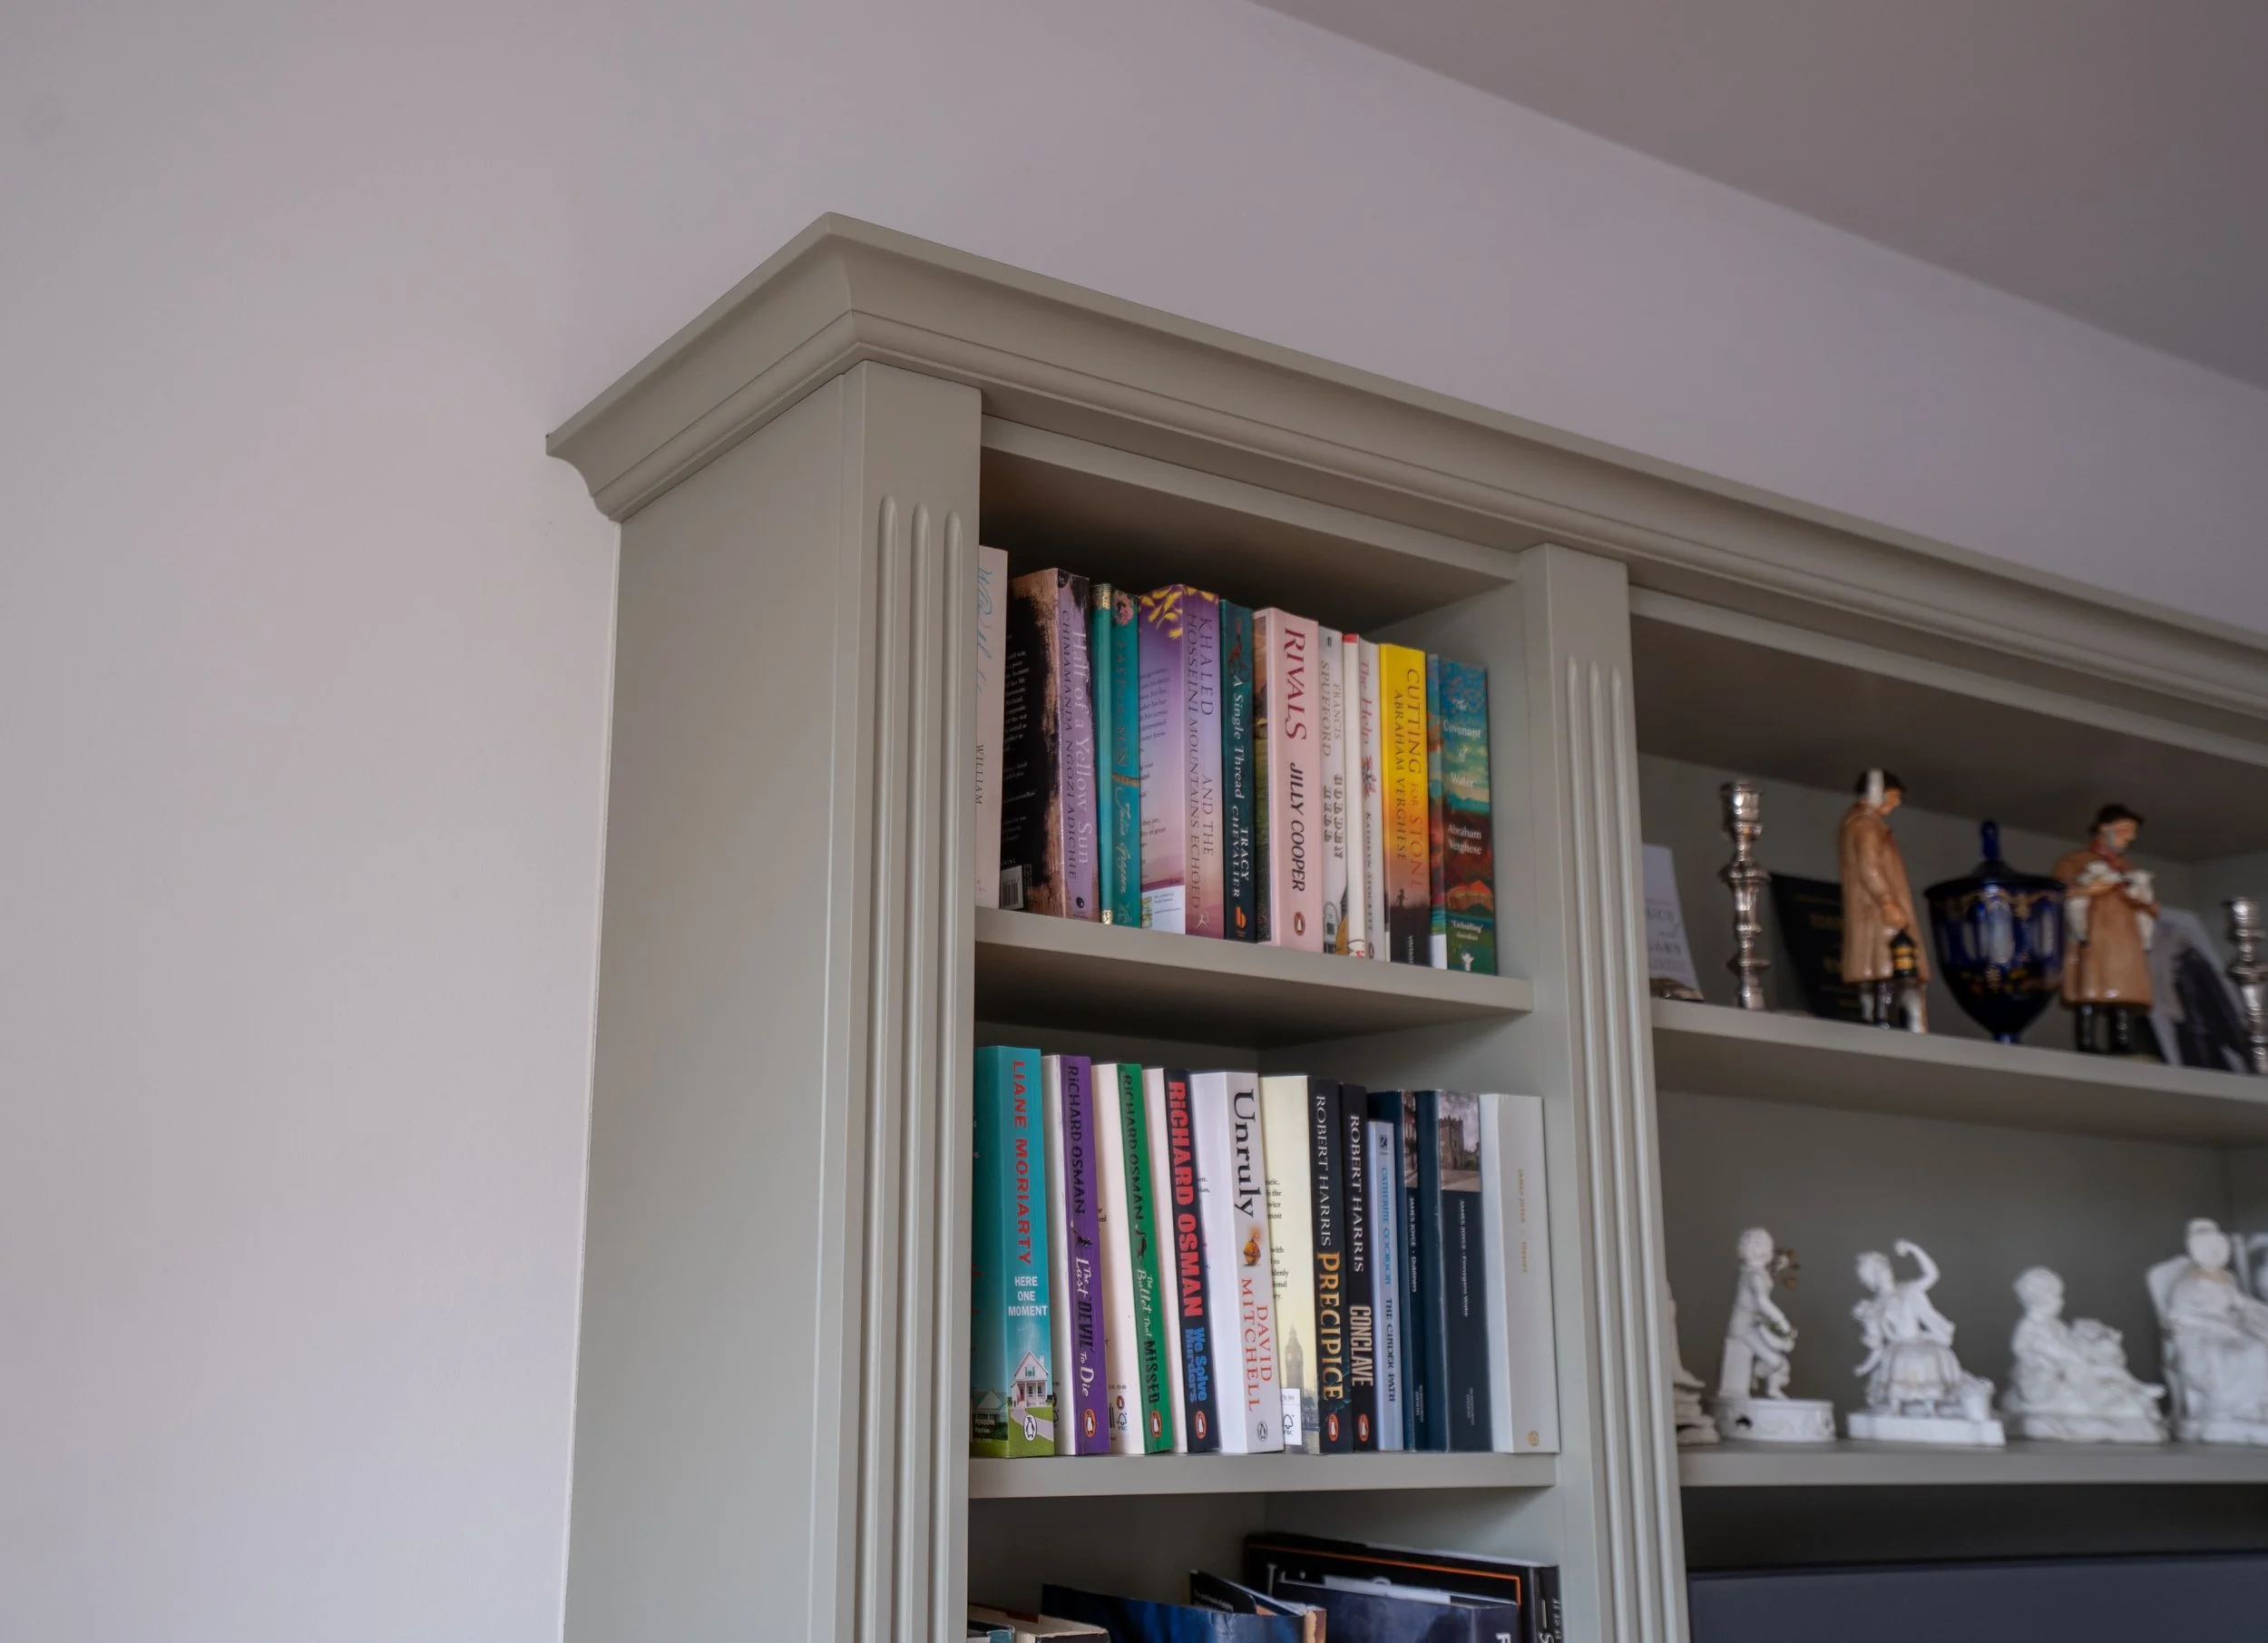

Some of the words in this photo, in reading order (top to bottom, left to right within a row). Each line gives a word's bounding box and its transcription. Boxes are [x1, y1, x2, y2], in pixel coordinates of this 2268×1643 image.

[1061, 610, 1073, 732] CHIMAMANDA
[1072, 631, 1089, 681] Half
[1187, 613, 1199, 711] HOSSEINI
[1199, 617, 1213, 716] KHALED
[1234, 675, 1244, 688] A
[1285, 628, 1307, 740] RIVALS
[1360, 660, 1371, 691] The
[1075, 688, 1088, 712] of
[1075, 718, 1087, 729] a
[1233, 693, 1244, 740] Single
[1321, 660, 1332, 757] SPUFFORD
[1333, 683, 1342, 740] FRANCIS
[1360, 696, 1372, 745] Help
[1394, 690, 1405, 770] ABRAHAM
[1407, 669, 1422, 774] CUTTING
[1443, 720, 1481, 738] Covenant
[1066, 739, 1075, 798] NGOZI
[1075, 732, 1091, 811] Yellow
[1188, 719, 1199, 831] MOUNTAINS
[1202, 774, 1213, 817] AND
[1234, 746, 1246, 798] Thread
[1289, 762, 1304, 817] JILLY
[1411, 783, 1420, 807] FOR
[1067, 805, 1076, 879] ADICHIE
[1078, 820, 1092, 864] Sun
[1203, 821, 1214, 856] THE
[1334, 773, 1344, 859] GOLDEN
[1396, 777, 1407, 862] VERGHESE
[1448, 823, 1482, 839] Abraham
[1448, 838, 1482, 856] Verghese
[1190, 835, 1201, 909] ECHOED
[1231, 805, 1240, 897] CHEVALIER
[1240, 827, 1249, 881] TRACY
[1291, 820, 1305, 892] COOPER
[1410, 814, 1423, 890] STONE
[1013, 1061, 1027, 1128] LIANE
[1234, 1090, 1261, 1218] Unruly
[1316, 1095, 1328, 1170] ROBERT
[1350, 1115, 1361, 1193] ROBERT
[1016, 1138, 1031, 1266] MORIARTY
[1071, 1146, 1086, 1214] OSMAN
[1129, 1154, 1144, 1219] OSMAN
[1319, 1175, 1332, 1247] HARRIS
[1178, 1214, 1203, 1316] OSMAN
[1353, 1197, 1364, 1273] HARRIS
[1383, 1227, 1392, 1285] COOKSON
[1013, 1276, 1039, 1286] HERE
[1017, 1291, 1036, 1301] ONE
[1076, 1257, 1091, 1296] Last
[1083, 1267, 1091, 1285] The
[1136, 1268, 1152, 1315] Bullet
[1144, 1316, 1152, 1337] That
[1008, 1306, 1047, 1315] MOMENT
[1078, 1296, 1094, 1354] DEVIL
[1194, 1326, 1204, 1353] We
[1317, 1252, 1343, 1401] PRECIPICE
[1385, 1298, 1393, 1322] THE
[1186, 1328, 1198, 1403] Murders
[1242, 1278, 1260, 1412] MITCHELL
[1257, 1306, 1272, 1382] DAVID
[1350, 1306, 1374, 1386] CONCLAVE
[1386, 1324, 1395, 1370] CINDER
[1080, 1365, 1094, 1397] Die
[1196, 1355, 1208, 1402] Solve
[1388, 1374, 1396, 1402] PATH
